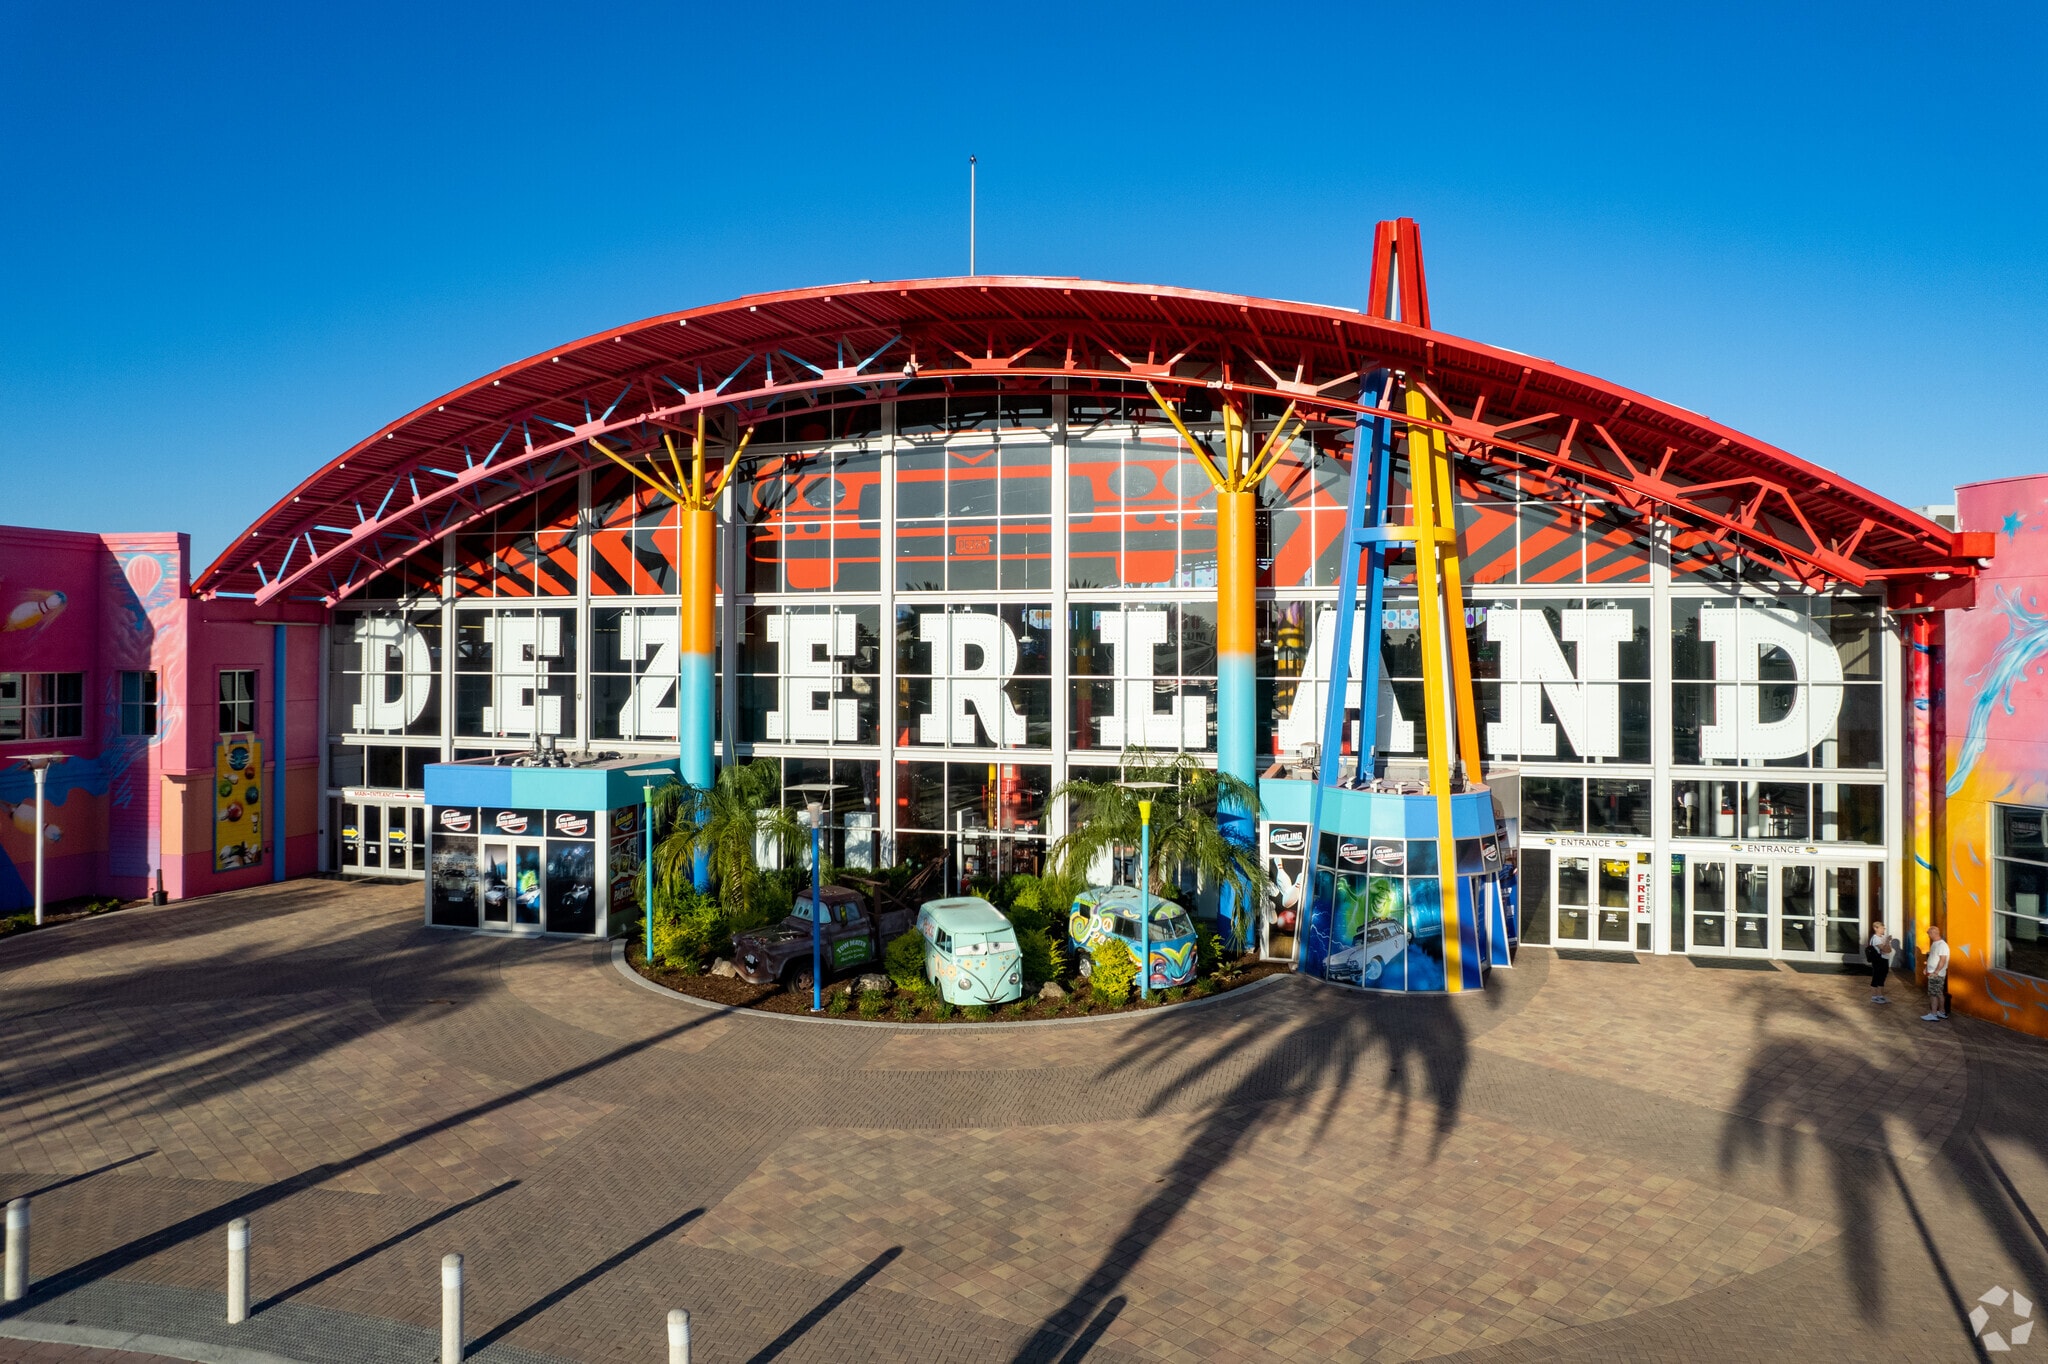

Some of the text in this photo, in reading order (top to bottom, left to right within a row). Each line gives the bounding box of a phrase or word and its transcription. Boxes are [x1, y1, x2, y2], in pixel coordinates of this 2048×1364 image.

[352, 608, 1844, 760] DEZERLAND
[1270, 831, 1303, 844] BOWLING
[1560, 838, 1611, 848] ENTRANCE
[1747, 844, 1800, 854] ENTRANCE
[1637, 873, 1646, 914] FREE
